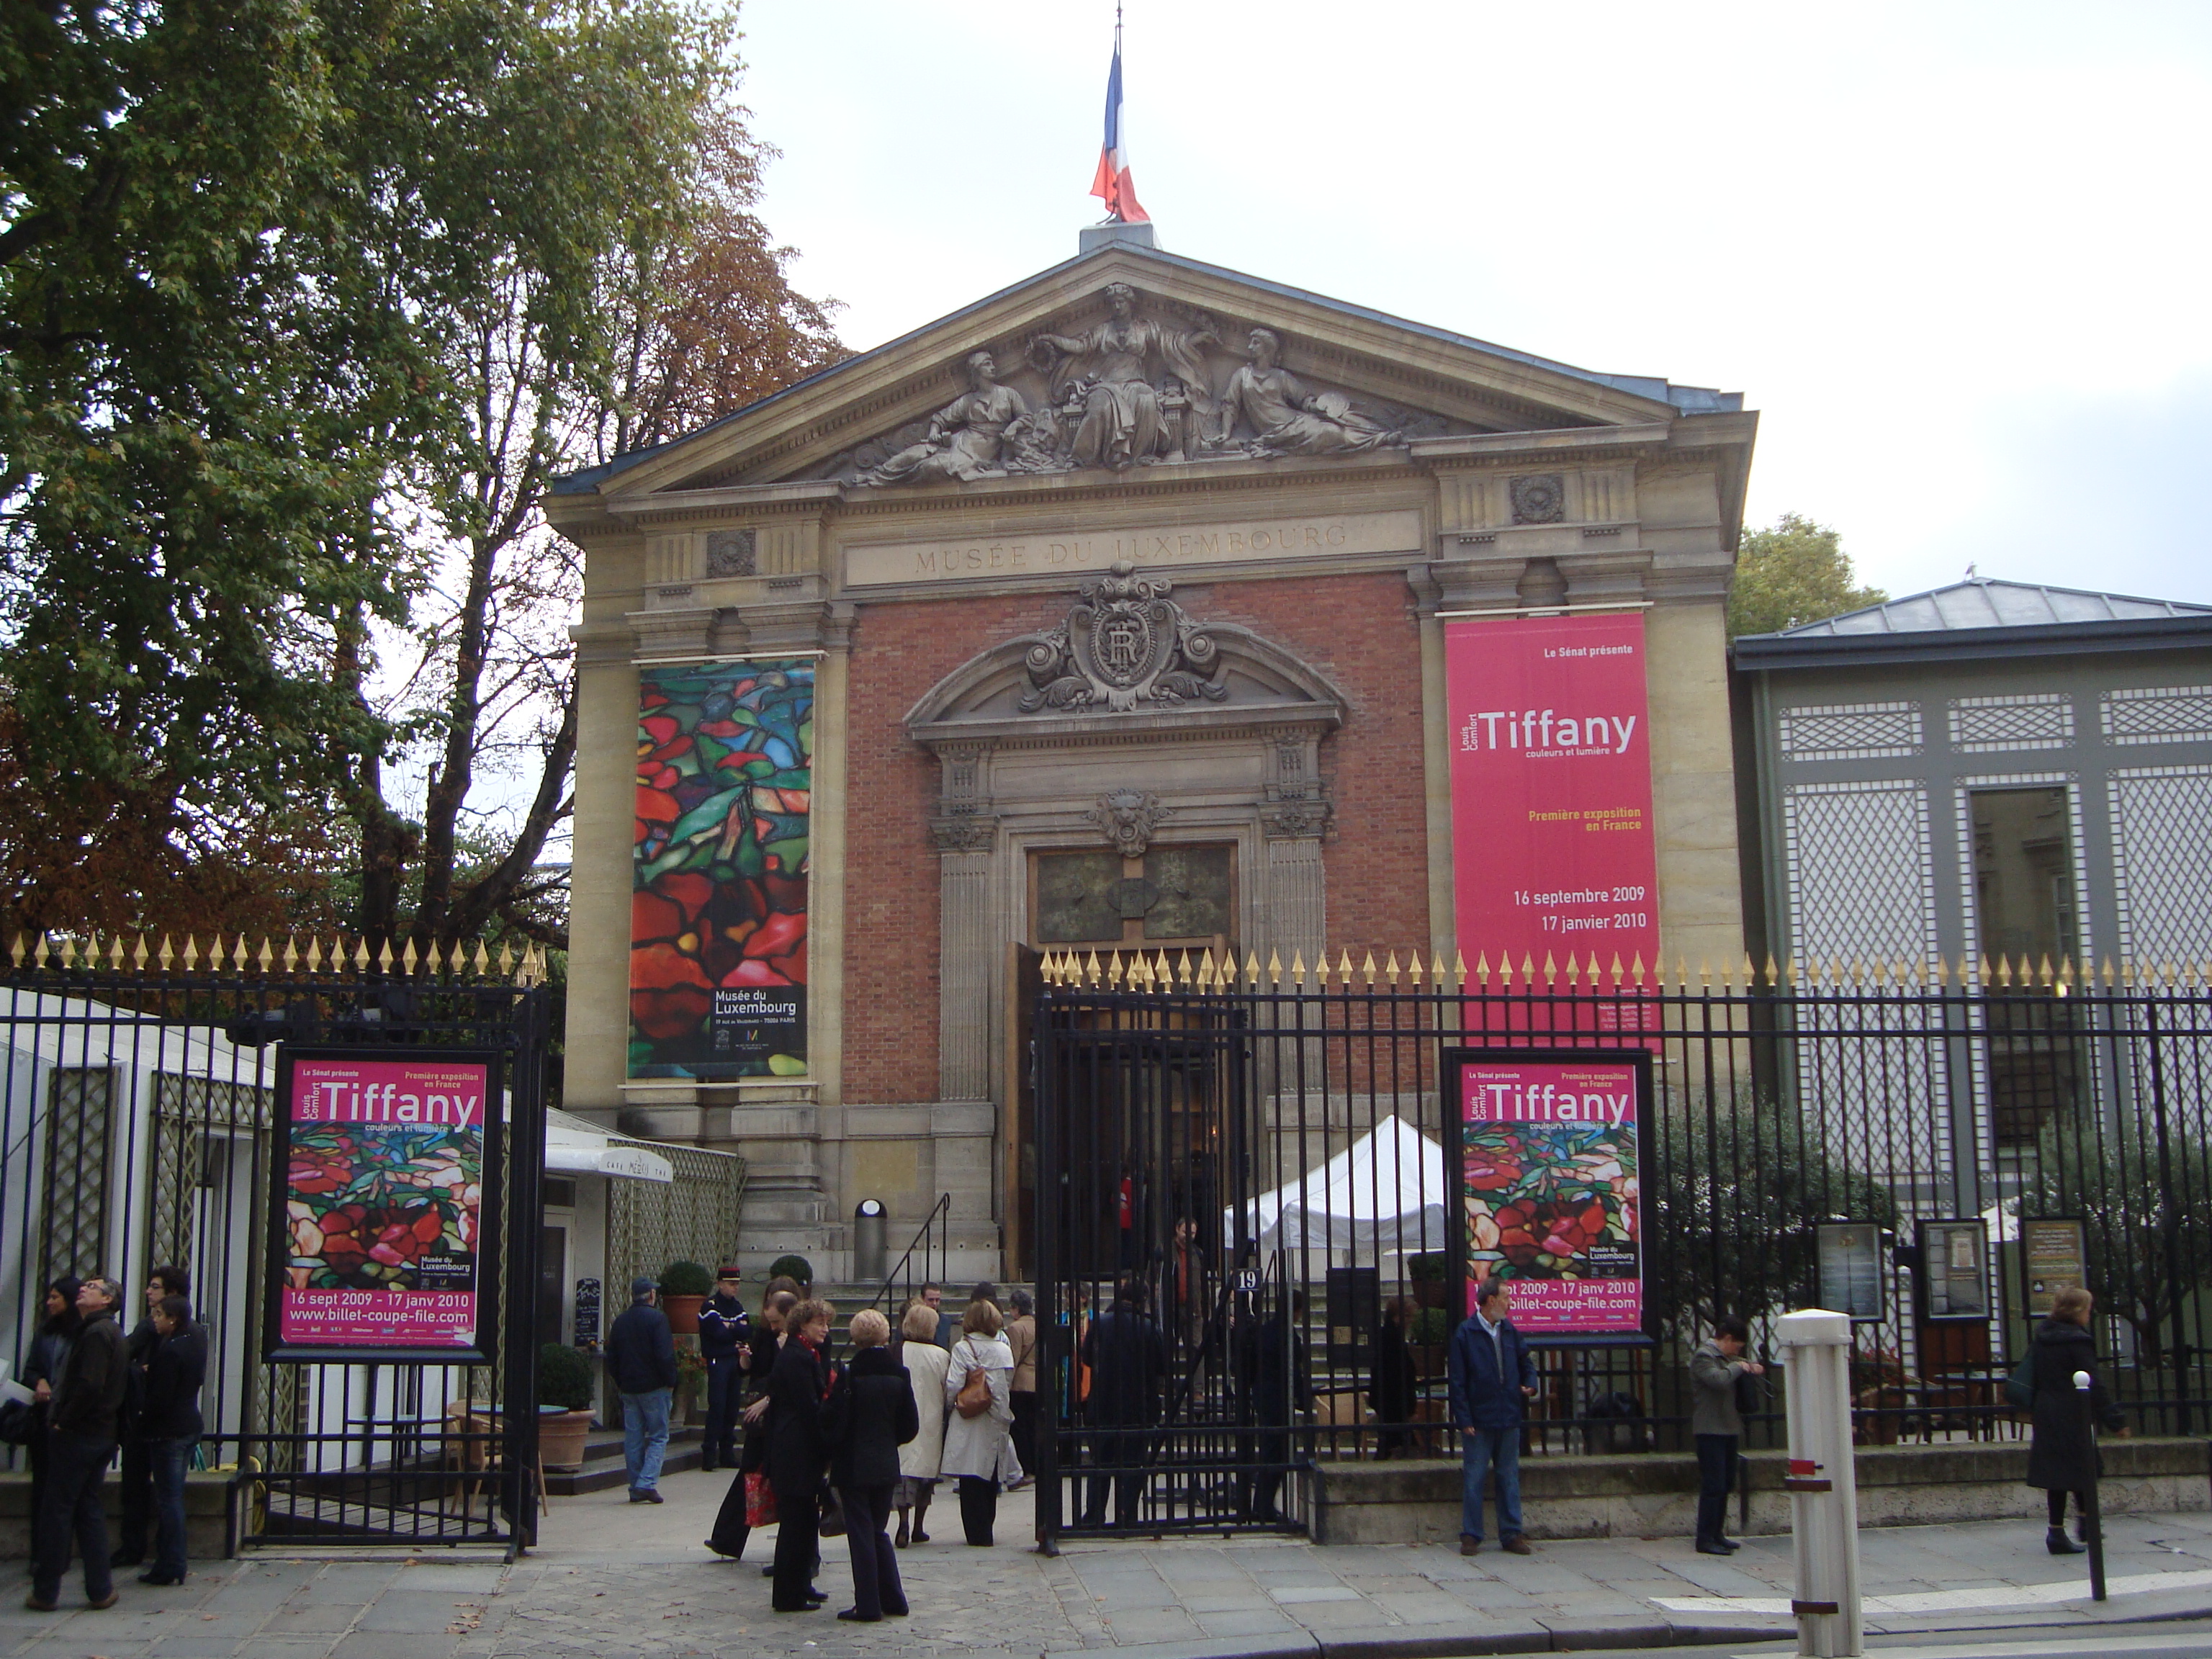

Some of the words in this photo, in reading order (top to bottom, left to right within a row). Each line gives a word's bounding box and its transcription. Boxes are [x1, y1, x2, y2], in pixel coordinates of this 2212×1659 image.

[916, 543, 1025, 572] MUSÉE
[1049, 541, 1091, 563] DU
[1116, 526, 1346, 559] LUXEMBOURG
[1544, 648, 1556, 657] Le
[1559, 647, 1587, 657] Sénat
[1589, 644, 1633, 657] présente
[1469, 714, 1478, 750] Comfort
[1478, 709, 1637, 754] Tiffany
[1526, 749, 1564, 757] couleurs
[1576, 746, 1610, 756] lumière
[1529, 809, 1580, 822] Première
[1583, 807, 1641, 821] exposition
[1604, 820, 1641, 830] France
[1514, 890, 1529, 905] 16
[1534, 888, 1609, 907] septembre
[1612, 886, 1645, 902] 2009
[1542, 916, 1557, 930] 17
[1561, 914, 1610, 933] janvier
[1614, 912, 1647, 928] 2010
[715, 990, 750, 1002] Musée
[753, 989, 766, 1000] du
[715, 1001, 796, 1015] Luxembourg
[405, 1071, 439, 1080] Première
[301, 1094, 311, 1120] Louis
[310, 1082, 320, 1120] Comfort
[321, 1082, 477, 1133] Tiffany
[1478, 1084, 1487, 1120] Comfort
[1486, 1084, 1629, 1130] Tiffany
[365, 1123, 403, 1132] couleurs
[415, 1123, 449, 1133] lumière
[1589, 1251, 1635, 1261] Luxembourg
[421, 1262, 471, 1273] Luxembourg
[1239, 1271, 1256, 1288] 19
[1521, 1282, 1548, 1295] 2009
[1562, 1282, 1575, 1294] 17
[1578, 1282, 1604, 1297] janv
[1607, 1282, 1635, 1294] 2010
[291, 1292, 305, 1305] 16
[309, 1294, 338, 1307] sept
[341, 1292, 372, 1305] 2009
[387, 1294, 403, 1306] 17
[405, 1295, 433, 1309] janv
[438, 1295, 469, 1308] 2010
[1475, 1297, 1636, 1312] billet-coupe-file.com
[290, 1308, 468, 1325] www.billet-coupe-file.com
